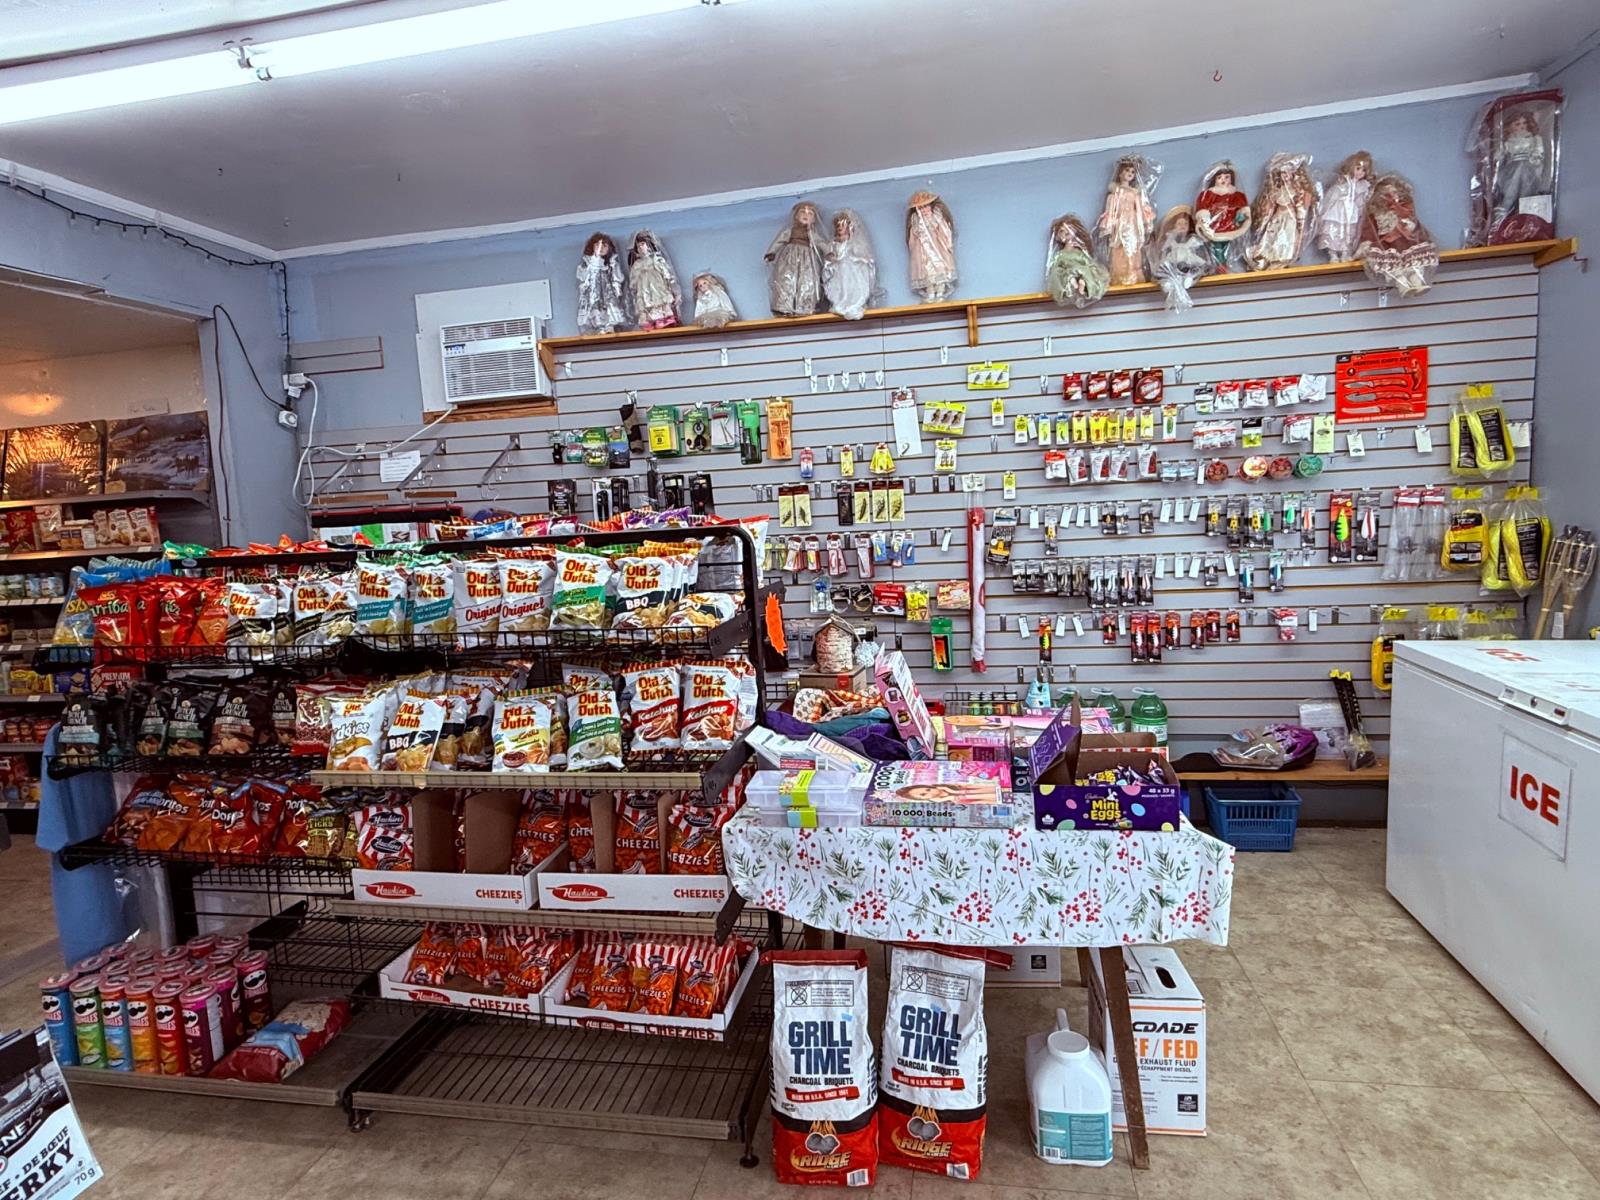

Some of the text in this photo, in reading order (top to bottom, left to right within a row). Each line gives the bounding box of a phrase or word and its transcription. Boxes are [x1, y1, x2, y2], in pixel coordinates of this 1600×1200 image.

[566, 559, 586, 571] Old
[627, 565, 647, 576] Old
[360, 571, 378, 583] Old
[467, 571, 487, 584] Old
[563, 571, 595, 584] Dutch
[627, 577, 658, 589] Dutch
[297, 588, 317, 600] Old
[360, 584, 389, 598] Dutch
[467, 585, 502, 598] Dutch
[507, 582, 539, 593] Dutch
[230, 593, 249, 605] Old
[626, 597, 649, 610] BBQ
[466, 604, 502, 622] Origina
[502, 598, 545, 618] Original
[639, 677, 659, 688] Old
[693, 673, 713, 685] Old
[579, 692, 598, 704] Old
[641, 687, 673, 701] Dutch
[693, 686, 724, 698] Dutch
[399, 703, 414, 714] Old
[579, 704, 612, 716] Dutch
[639, 704, 678, 721] Ketchup
[687, 705, 728, 720] Ketchup
[393, 714, 421, 728] Dutch
[501, 717, 534, 730] Dutch
[389, 736, 410, 750] BBQ
[1510, 765, 1560, 827] ICE
[1091, 799, 1120, 810] Mini
[892, 809, 953, 818] 10 000 Beads
[1090, 809, 1122, 822] Eggs
[309, 820, 334, 829] TICKS
[516, 829, 556, 843] HEEZIES
[616, 837, 660, 849] CHEEZIE
[667, 852, 711, 866] HEEZIES
[375, 883, 408, 896] Hawkins
[476, 888, 523, 900] CHEEZIES
[563, 886, 599, 898] Hawkins
[673, 888, 725, 899] CHEEZIES
[416, 949, 446, 958] CHEEZIES
[591, 985, 626, 994] CHEEZIES
[469, 998, 531, 1013] CHEEZIES
[900, 1005, 962, 1041] GRILL
[788, 1020, 853, 1047] GRILL
[900, 1030, 960, 1066] TIME
[1162, 1038, 1198, 1059] FED
[790, 1048, 851, 1075] TIME
[897, 1057, 960, 1077] CHARCOAL BRIQUETS
[1140, 1058, 1197, 1067] EXHAUST FLUID
[789, 1076, 854, 1087] CHARCOAL BRIQUETS
[0, 1107, 44, 1150] NEY'S
[22, 1156, 40, 1175] DE
[40, 1125, 70, 1160] BŒUF
[901, 1139, 953, 1153] RIDGE
[0, 1137, 74, 1200] ERKY
[74, 1167, 96, 1186] 70 g
